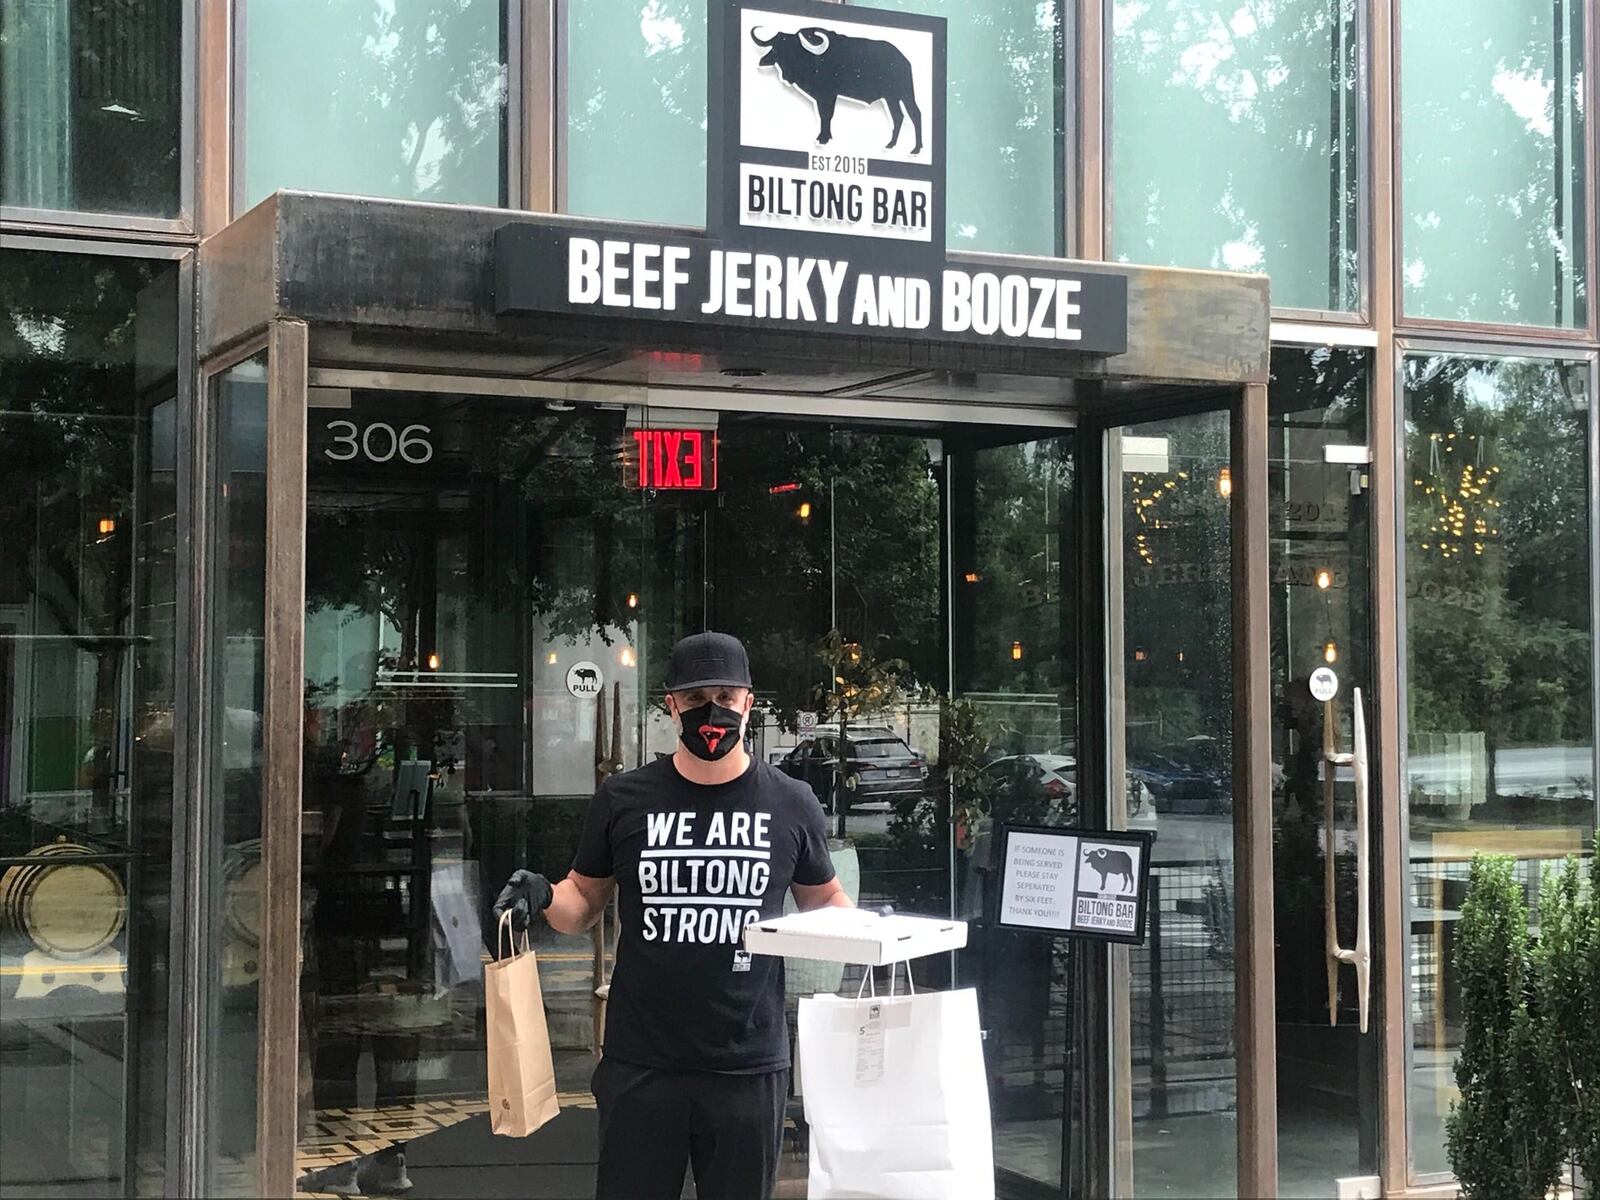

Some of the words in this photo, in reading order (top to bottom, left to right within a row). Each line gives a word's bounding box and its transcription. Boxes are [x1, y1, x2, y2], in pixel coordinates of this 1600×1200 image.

[748, 174, 863, 222] BILTONG
[873, 187, 927, 228] BAR
[568, 237, 691, 311] BEEF
[701, 250, 849, 324] JERKY
[851, 273, 931, 330] AND
[942, 270, 1082, 341] BOOZE
[324, 420, 433, 464] 306
[573, 684, 597, 692] PULL
[647, 811, 697, 847] WE
[705, 811, 771, 848] ARE
[1013, 858, 1036, 867] BEING
[1036, 859, 1063, 869] SERVED
[638, 859, 770, 897] BILTONG
[1015, 869, 1041, 879] PLEASE
[1041, 871, 1059, 880] STAY
[1009, 906, 1033, 916] THANK
[1078, 899, 1114, 917] BILTONG
[1115, 903, 1134, 919] BAR
[1077, 914, 1090, 924] BEEF
[1090, 915, 1107, 926] JERKY
